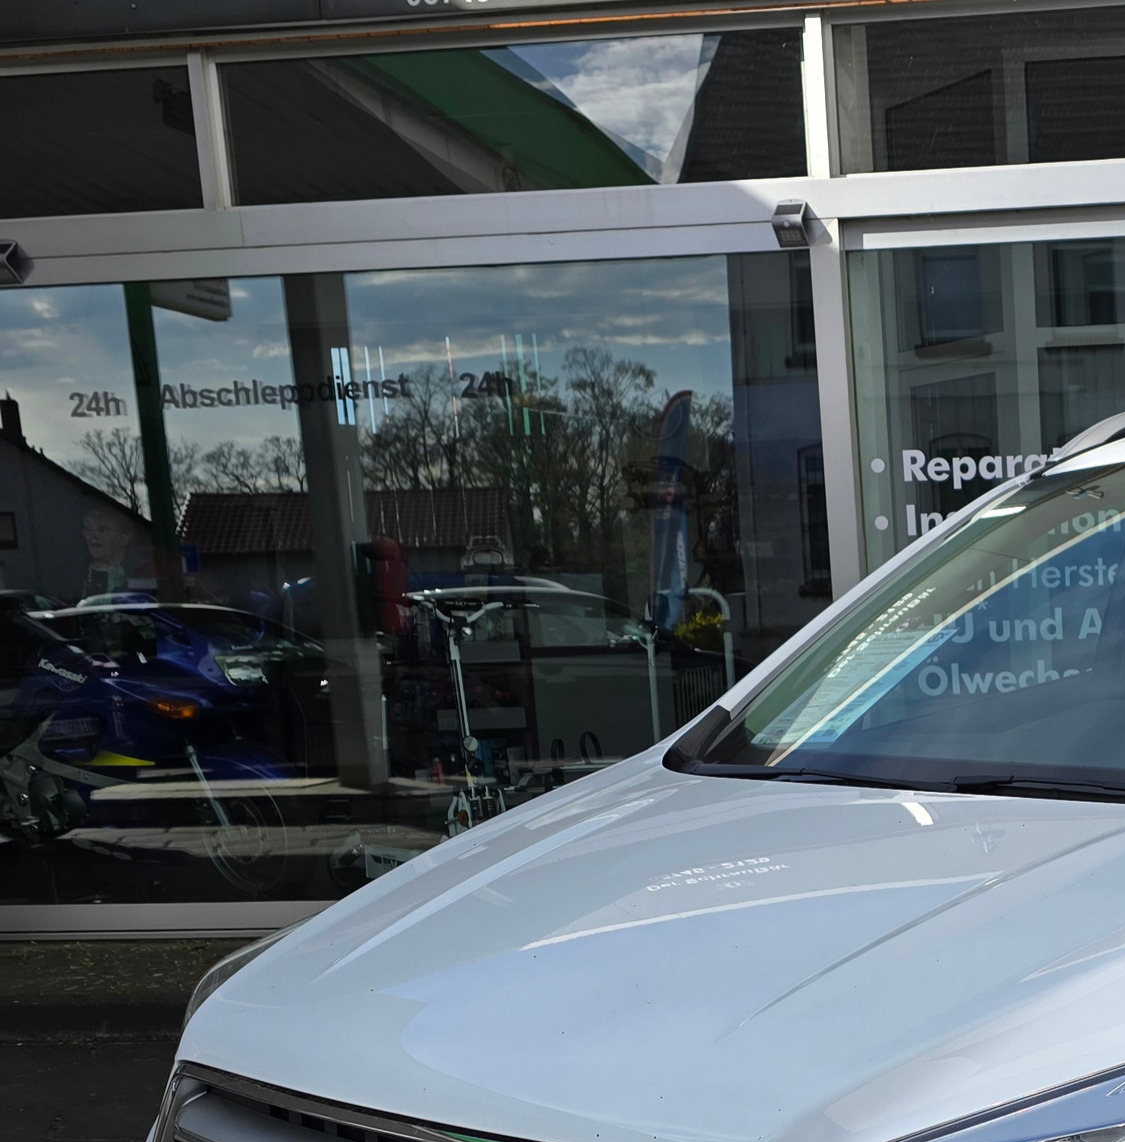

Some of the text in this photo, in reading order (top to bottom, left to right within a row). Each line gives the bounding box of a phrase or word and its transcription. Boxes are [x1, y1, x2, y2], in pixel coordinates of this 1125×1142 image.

[68, 371, 513, 417] 24h Abschleppdienst 24h
[988, 607, 1063, 642] und
